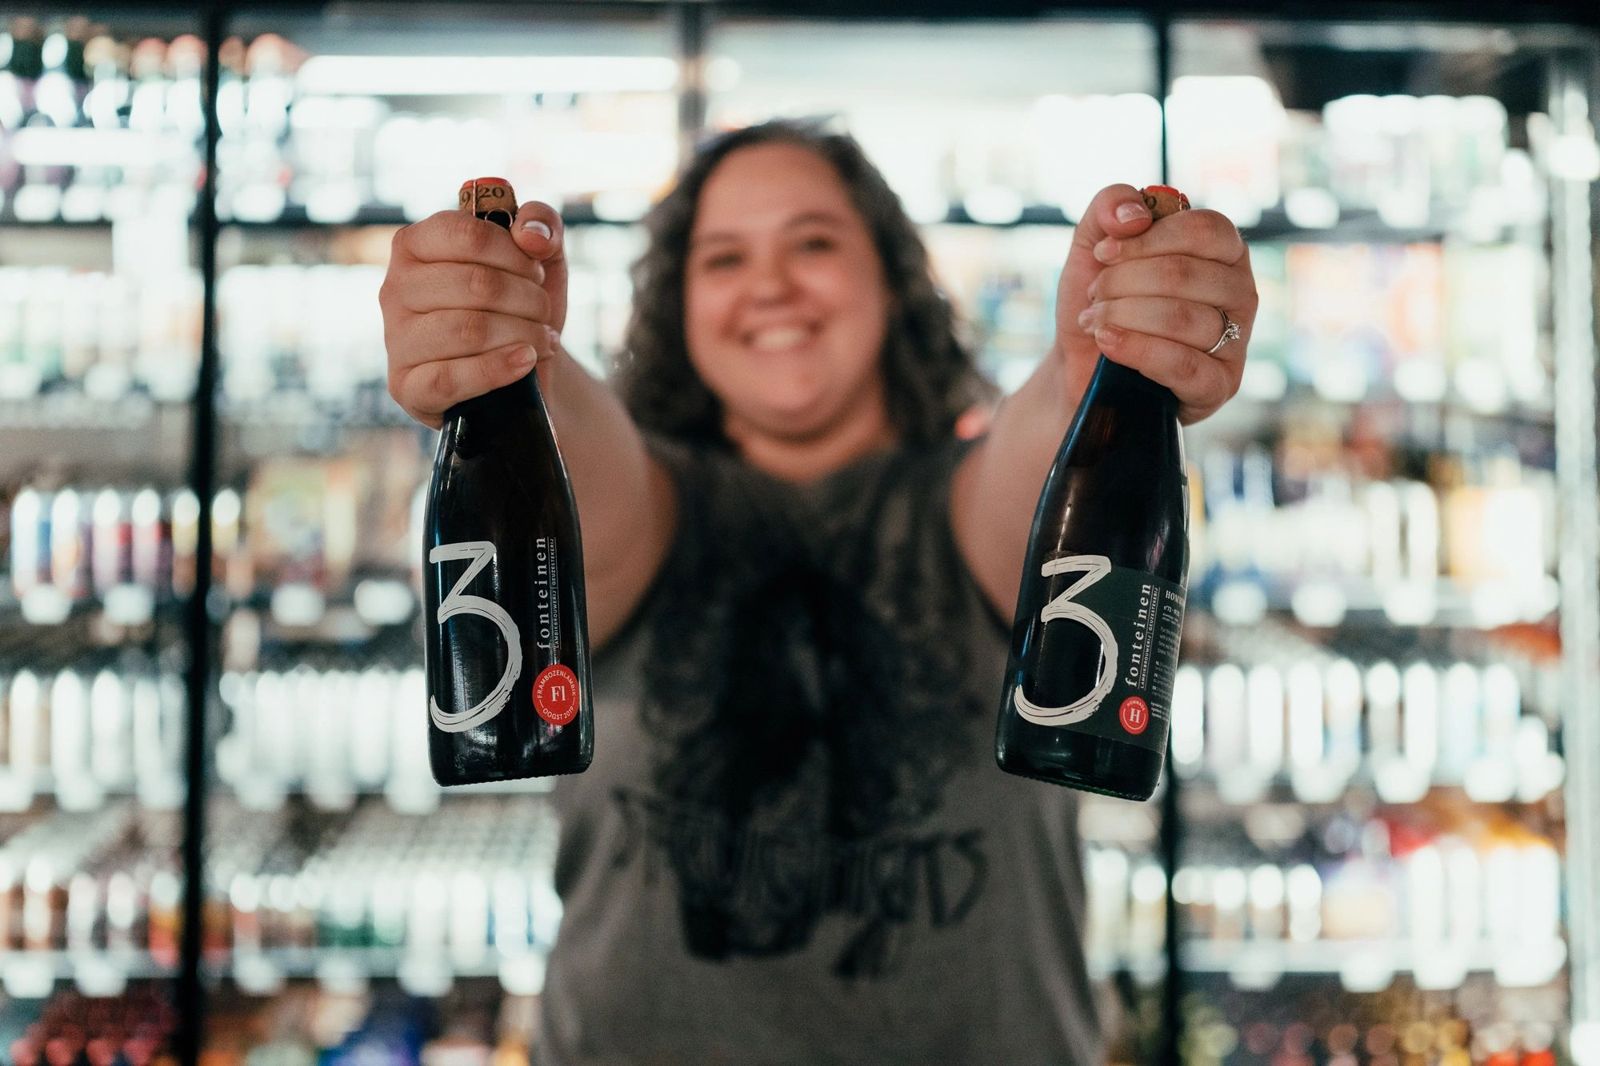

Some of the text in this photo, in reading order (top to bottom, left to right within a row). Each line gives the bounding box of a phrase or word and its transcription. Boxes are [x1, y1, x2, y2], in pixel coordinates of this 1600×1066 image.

[429, 541, 523, 733] 3
[534, 537, 549, 649] fonteinen
[1014, 554, 1118, 726] 3
[1125, 584, 1151, 687] fonteinen
[536, 669, 577, 699] FRAMBOZENLAMBIK
[542, 707, 563, 720] OOGST
[1129, 707, 1141, 723] H
